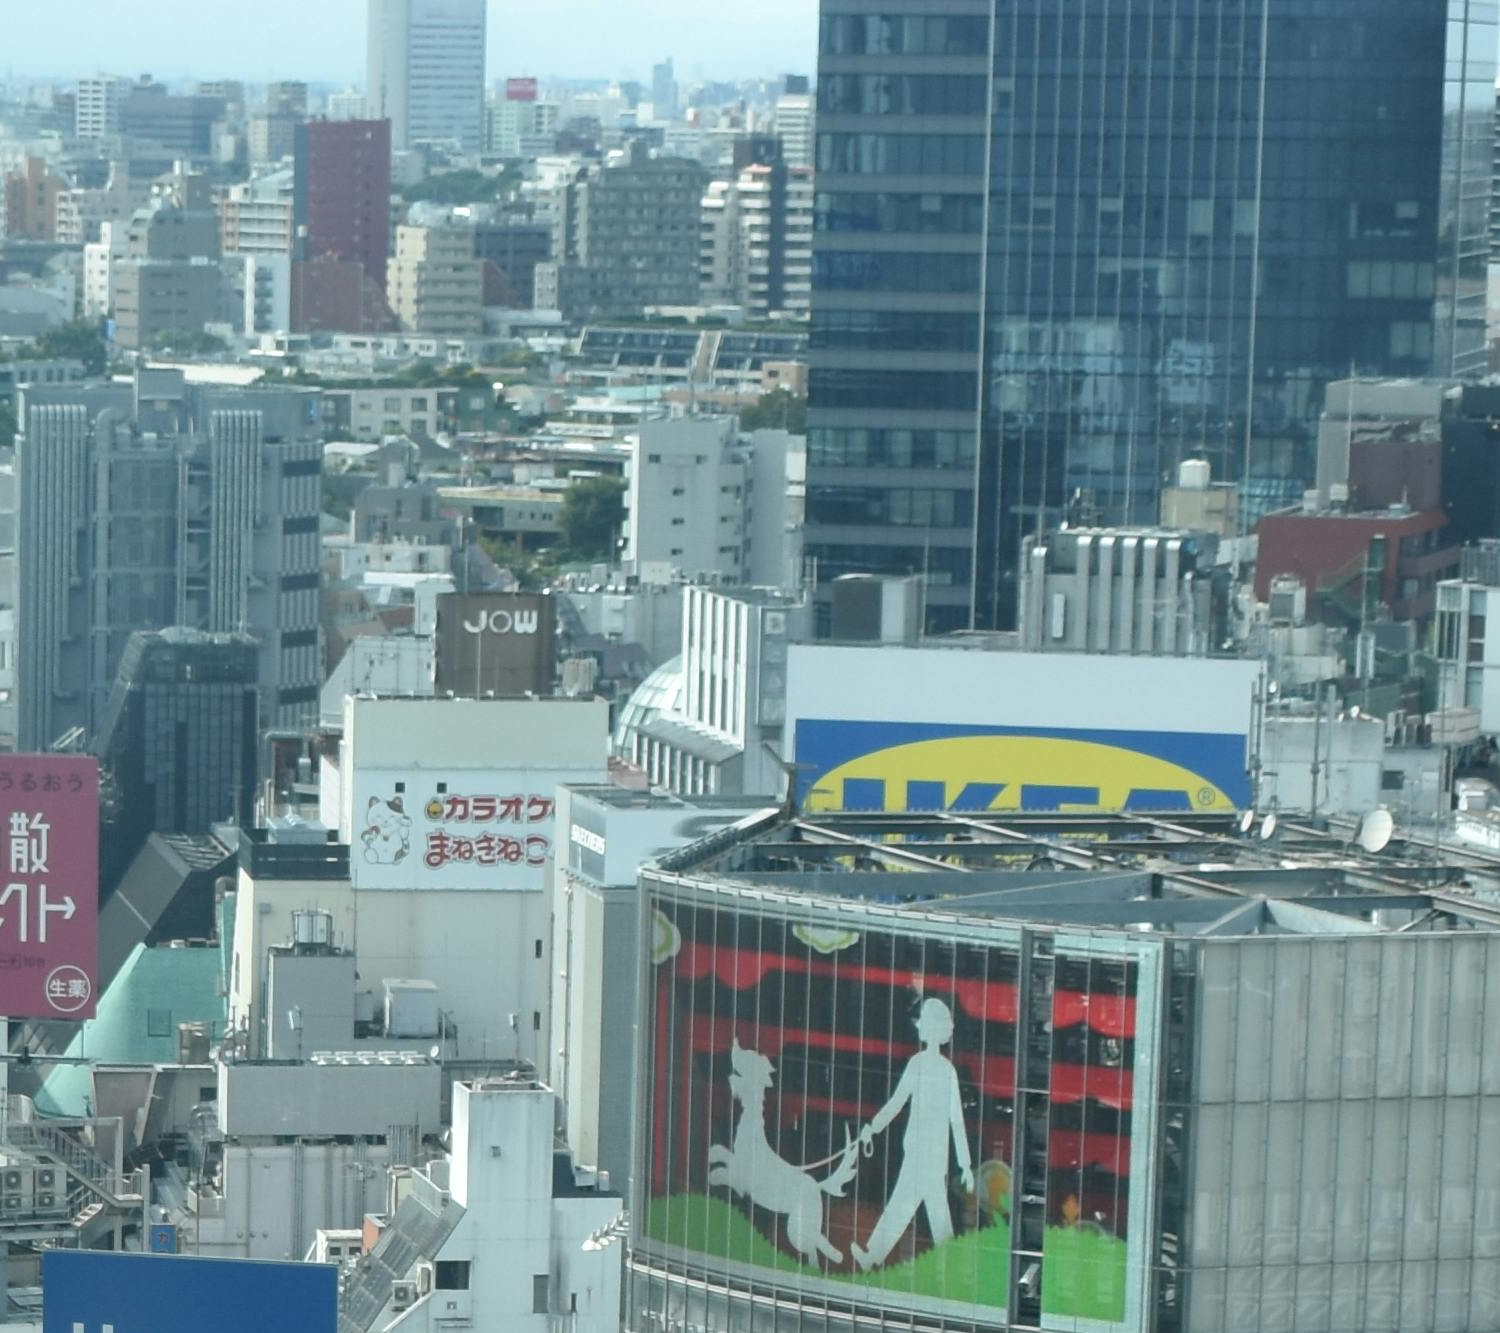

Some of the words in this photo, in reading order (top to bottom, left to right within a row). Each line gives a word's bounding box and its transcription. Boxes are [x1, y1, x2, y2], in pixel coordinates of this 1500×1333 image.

[462, 606, 538, 635] JOW
[443, 794, 555, 824] カラオケ
[424, 828, 553, 872] まねきねこ
[48, 977, 87, 1001] 生薬
